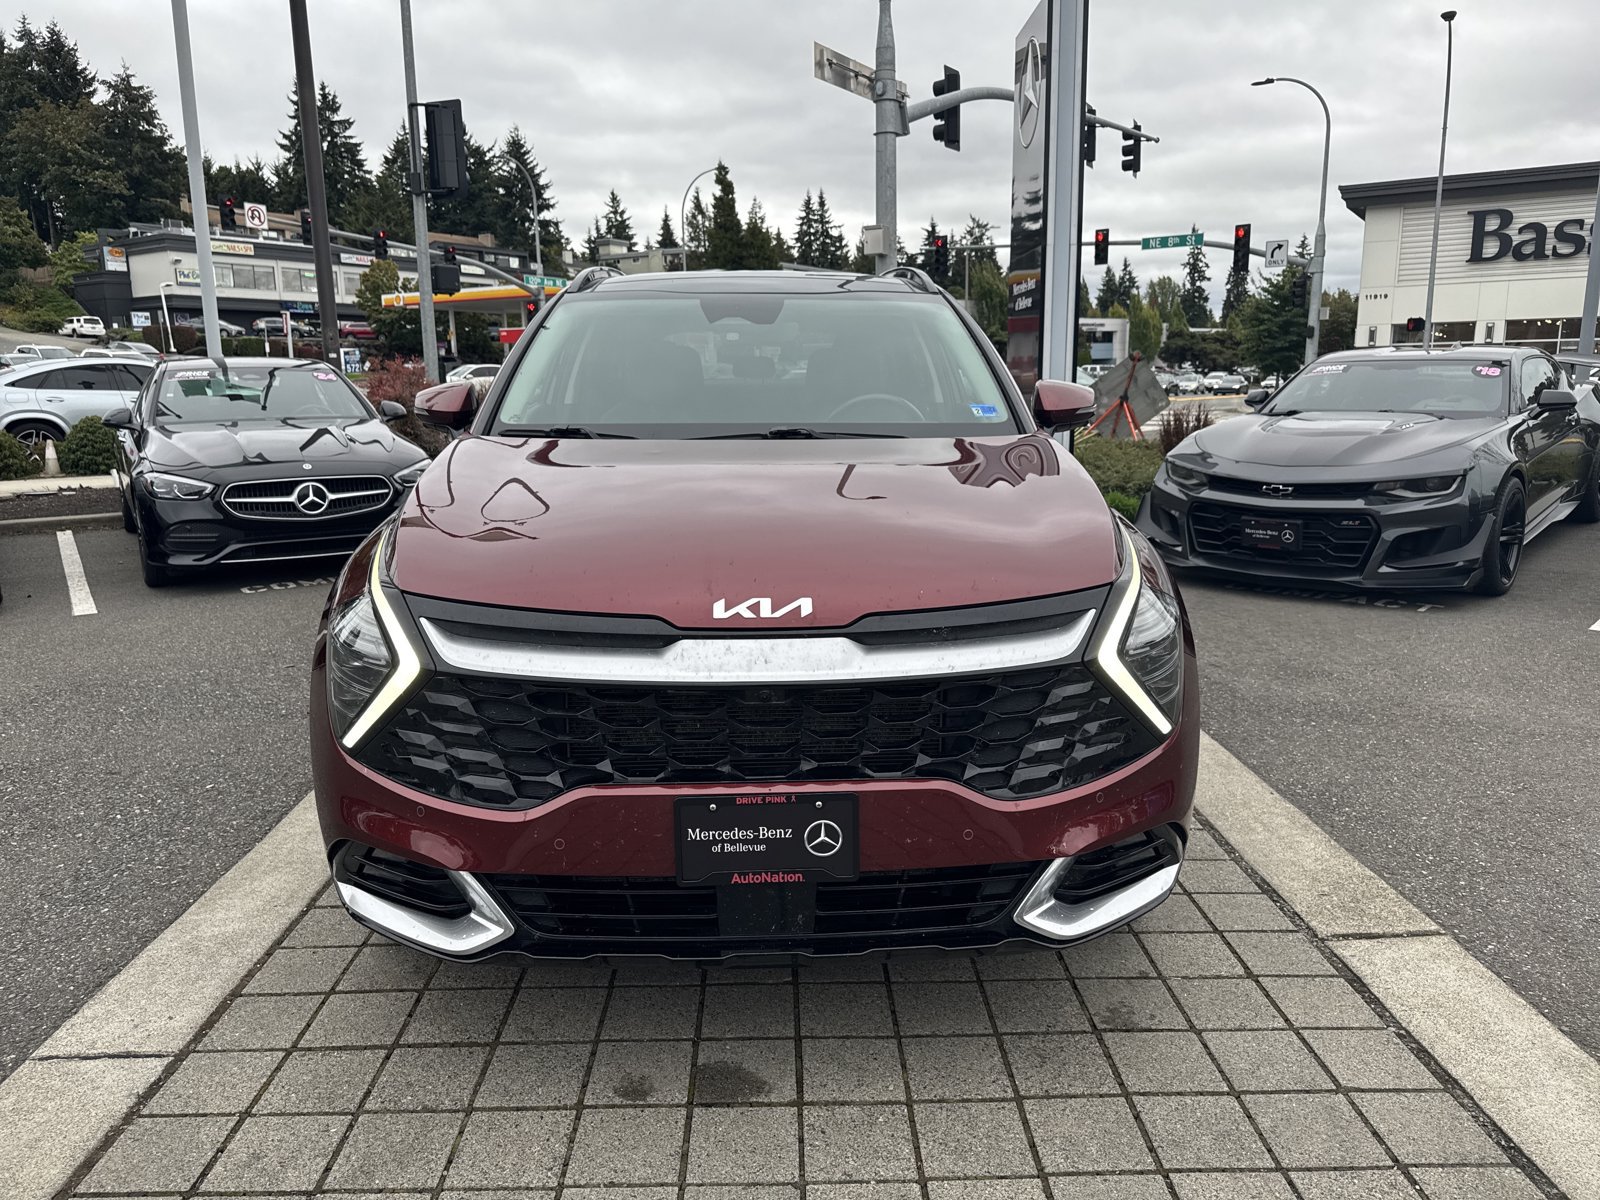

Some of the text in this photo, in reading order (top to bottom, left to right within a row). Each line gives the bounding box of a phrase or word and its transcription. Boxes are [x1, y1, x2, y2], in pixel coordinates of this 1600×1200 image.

[1149, 235, 1195, 248] NE 8th St
[1465, 208, 1593, 263] Bas
[736, 795, 787, 805] DRIVE PINK
[687, 826, 793, 841] Mercedes-Benz
[711, 842, 766, 853] of Bellevue
